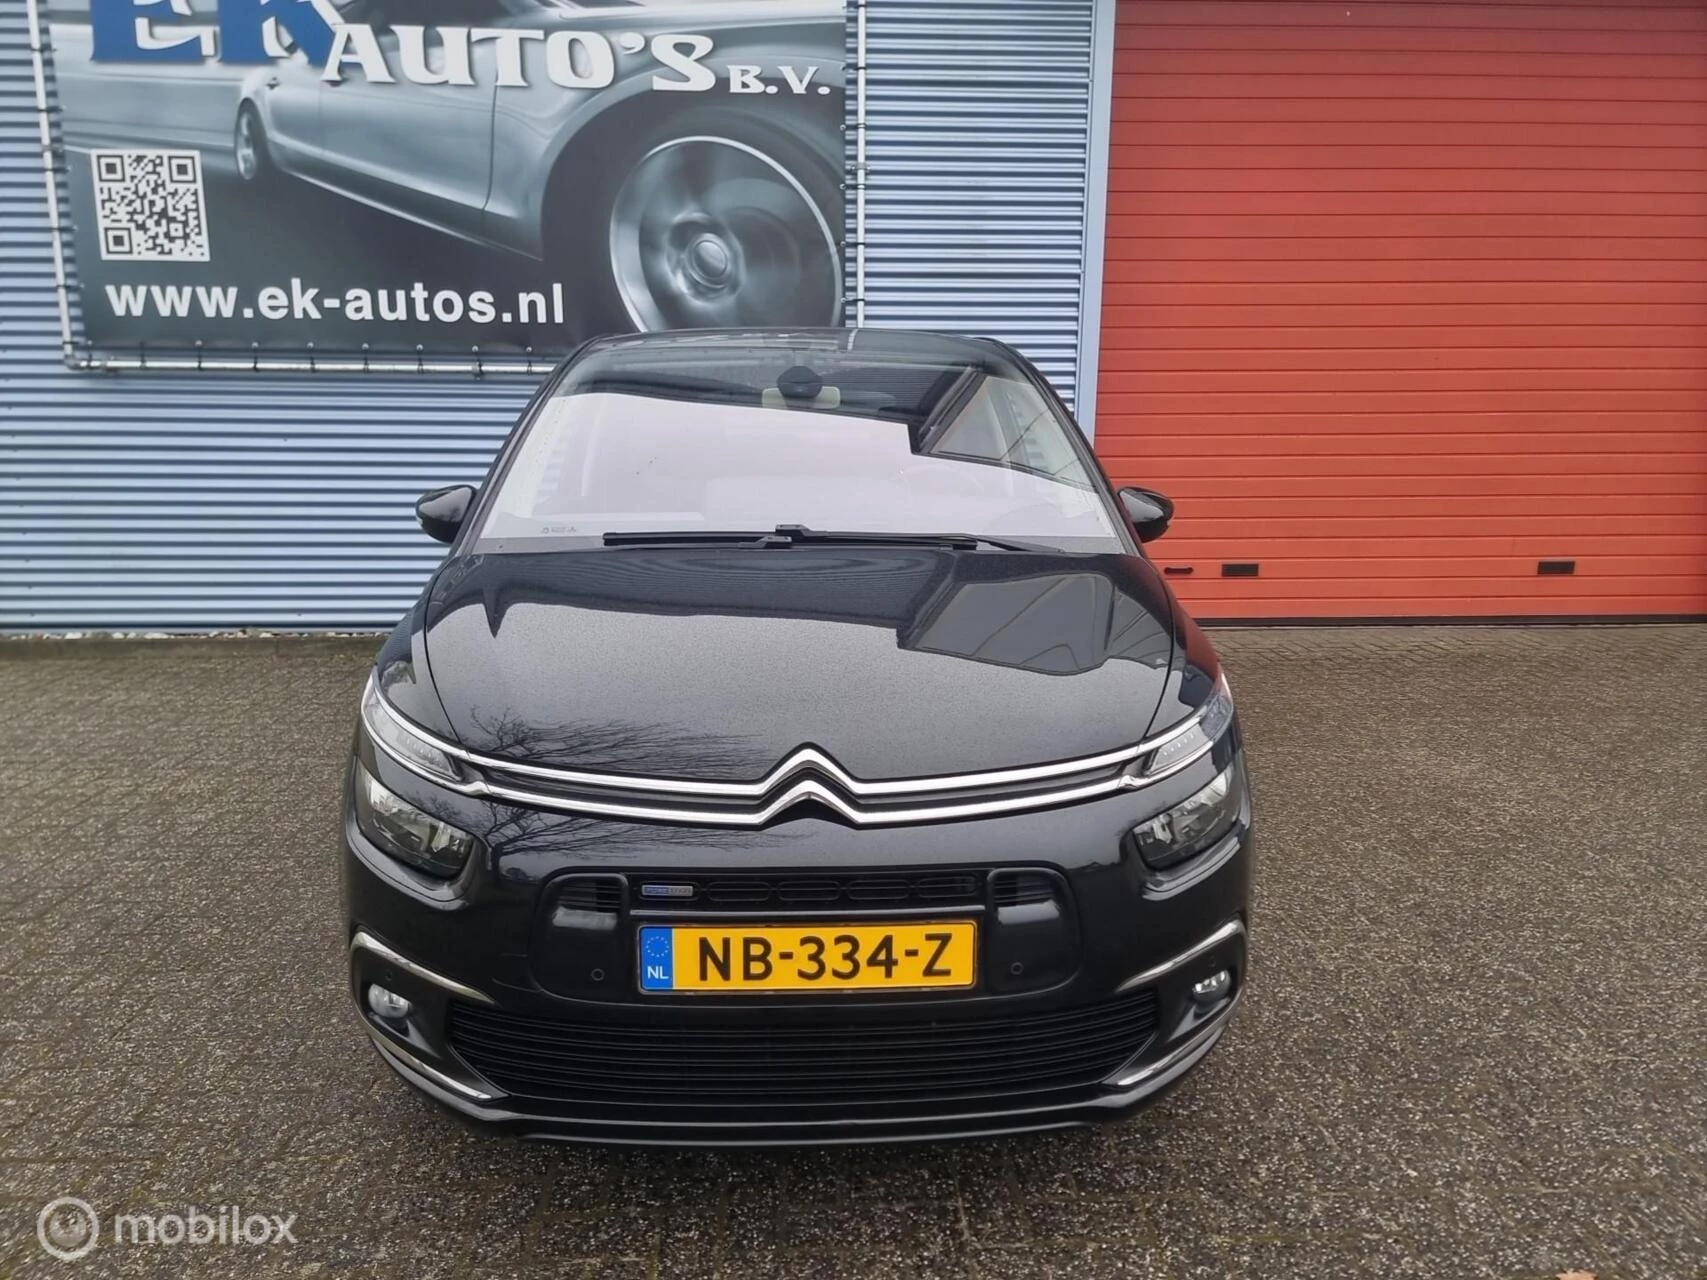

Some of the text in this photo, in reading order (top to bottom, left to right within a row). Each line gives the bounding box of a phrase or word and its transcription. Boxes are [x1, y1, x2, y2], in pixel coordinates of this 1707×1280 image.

[90, 0, 831, 95] EK AUTO'S B.V.
[105, 277, 564, 323] www.ek-autos.nl
[647, 965, 669, 979] NL
[698, 932, 953, 981] NB-334-Z
